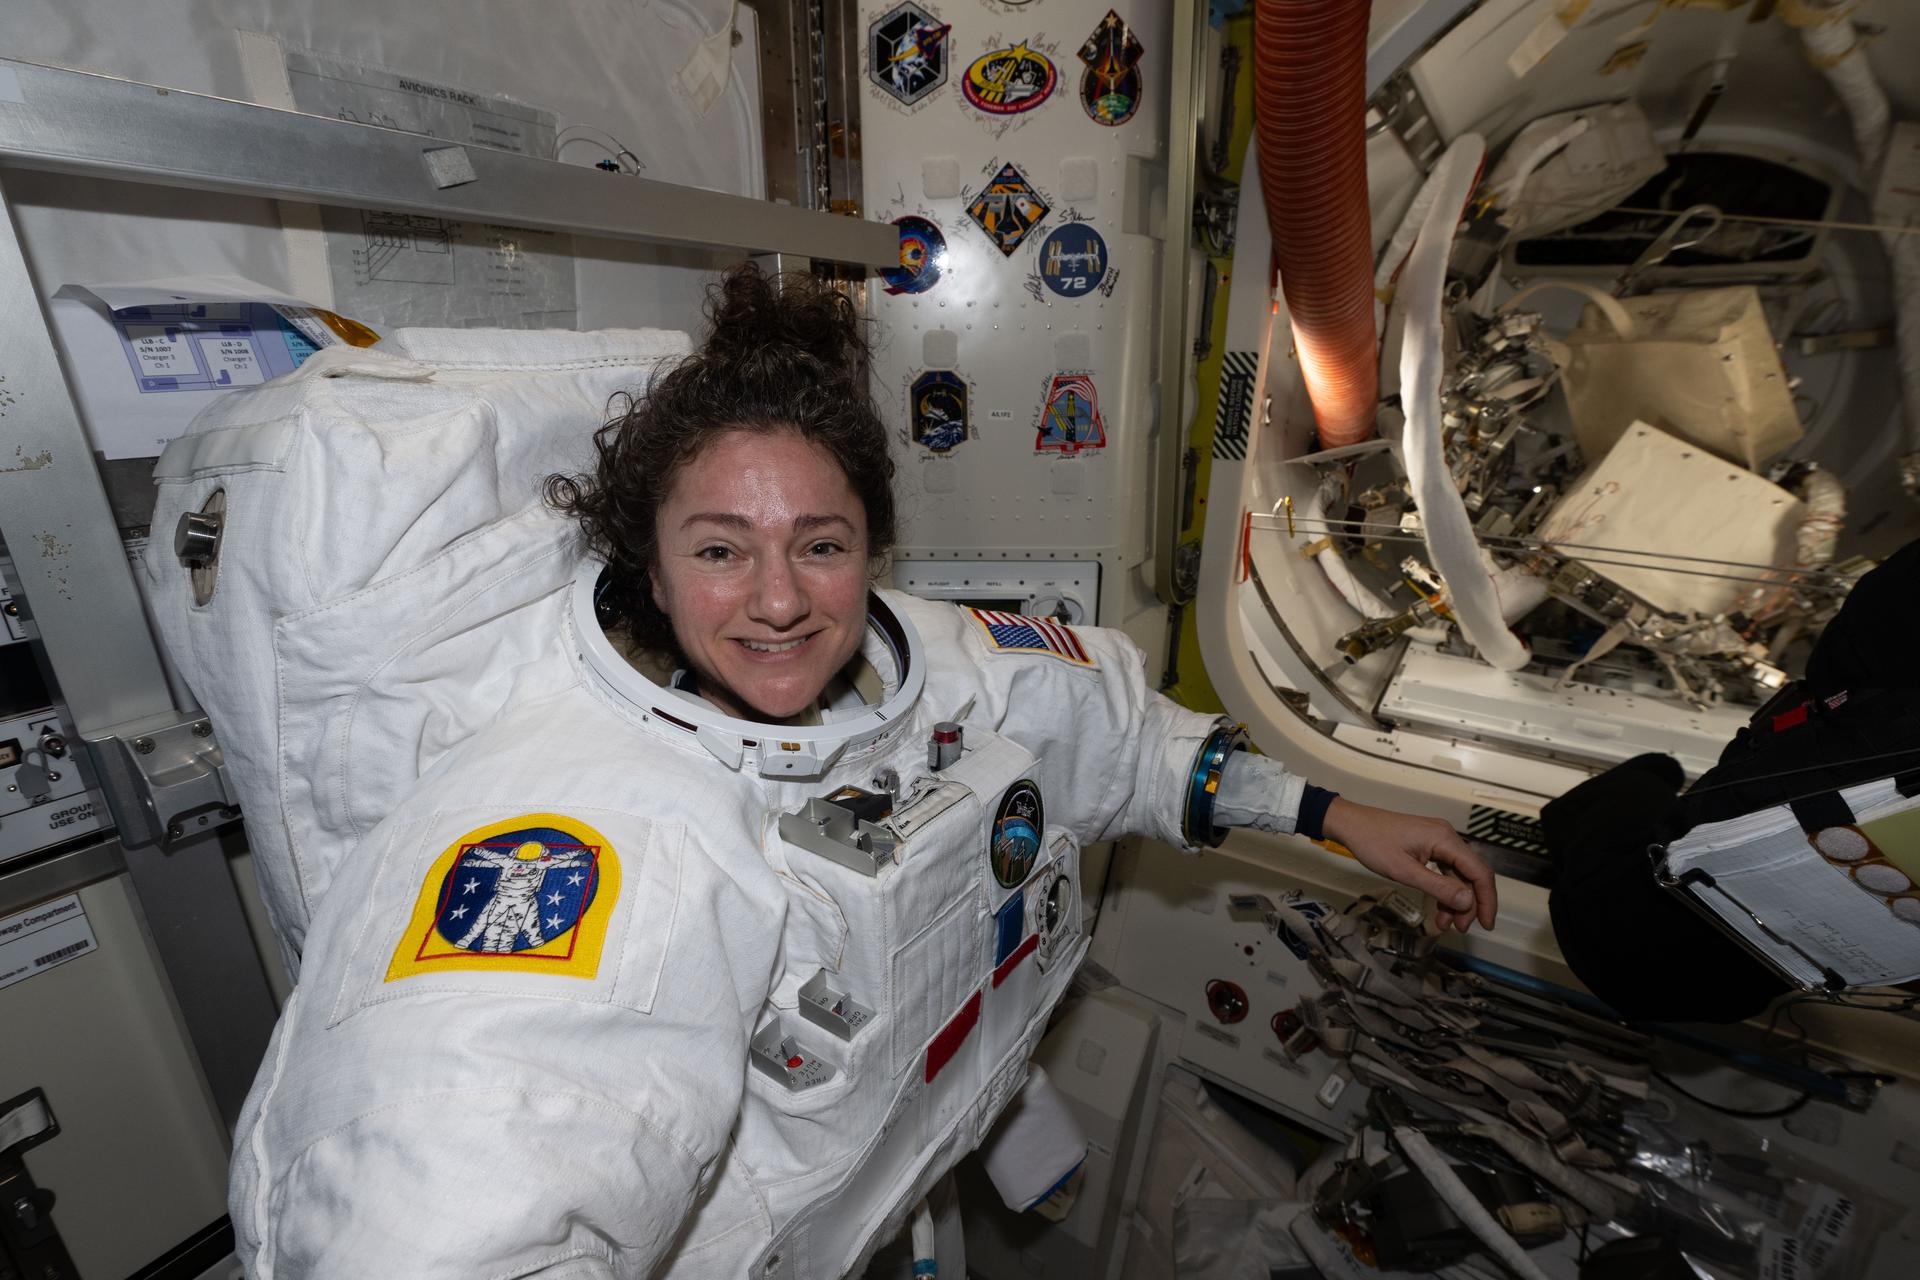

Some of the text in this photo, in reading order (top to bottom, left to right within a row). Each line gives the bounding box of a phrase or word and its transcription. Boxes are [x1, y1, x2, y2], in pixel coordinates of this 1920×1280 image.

[399, 80, 477, 106] AVIONICS RACK
[1060, 277, 1087, 290] 72
[49, 816, 76, 830] USE
[23, 902, 77, 927] Compartment
[1826, 1198, 1855, 1237] Waist
